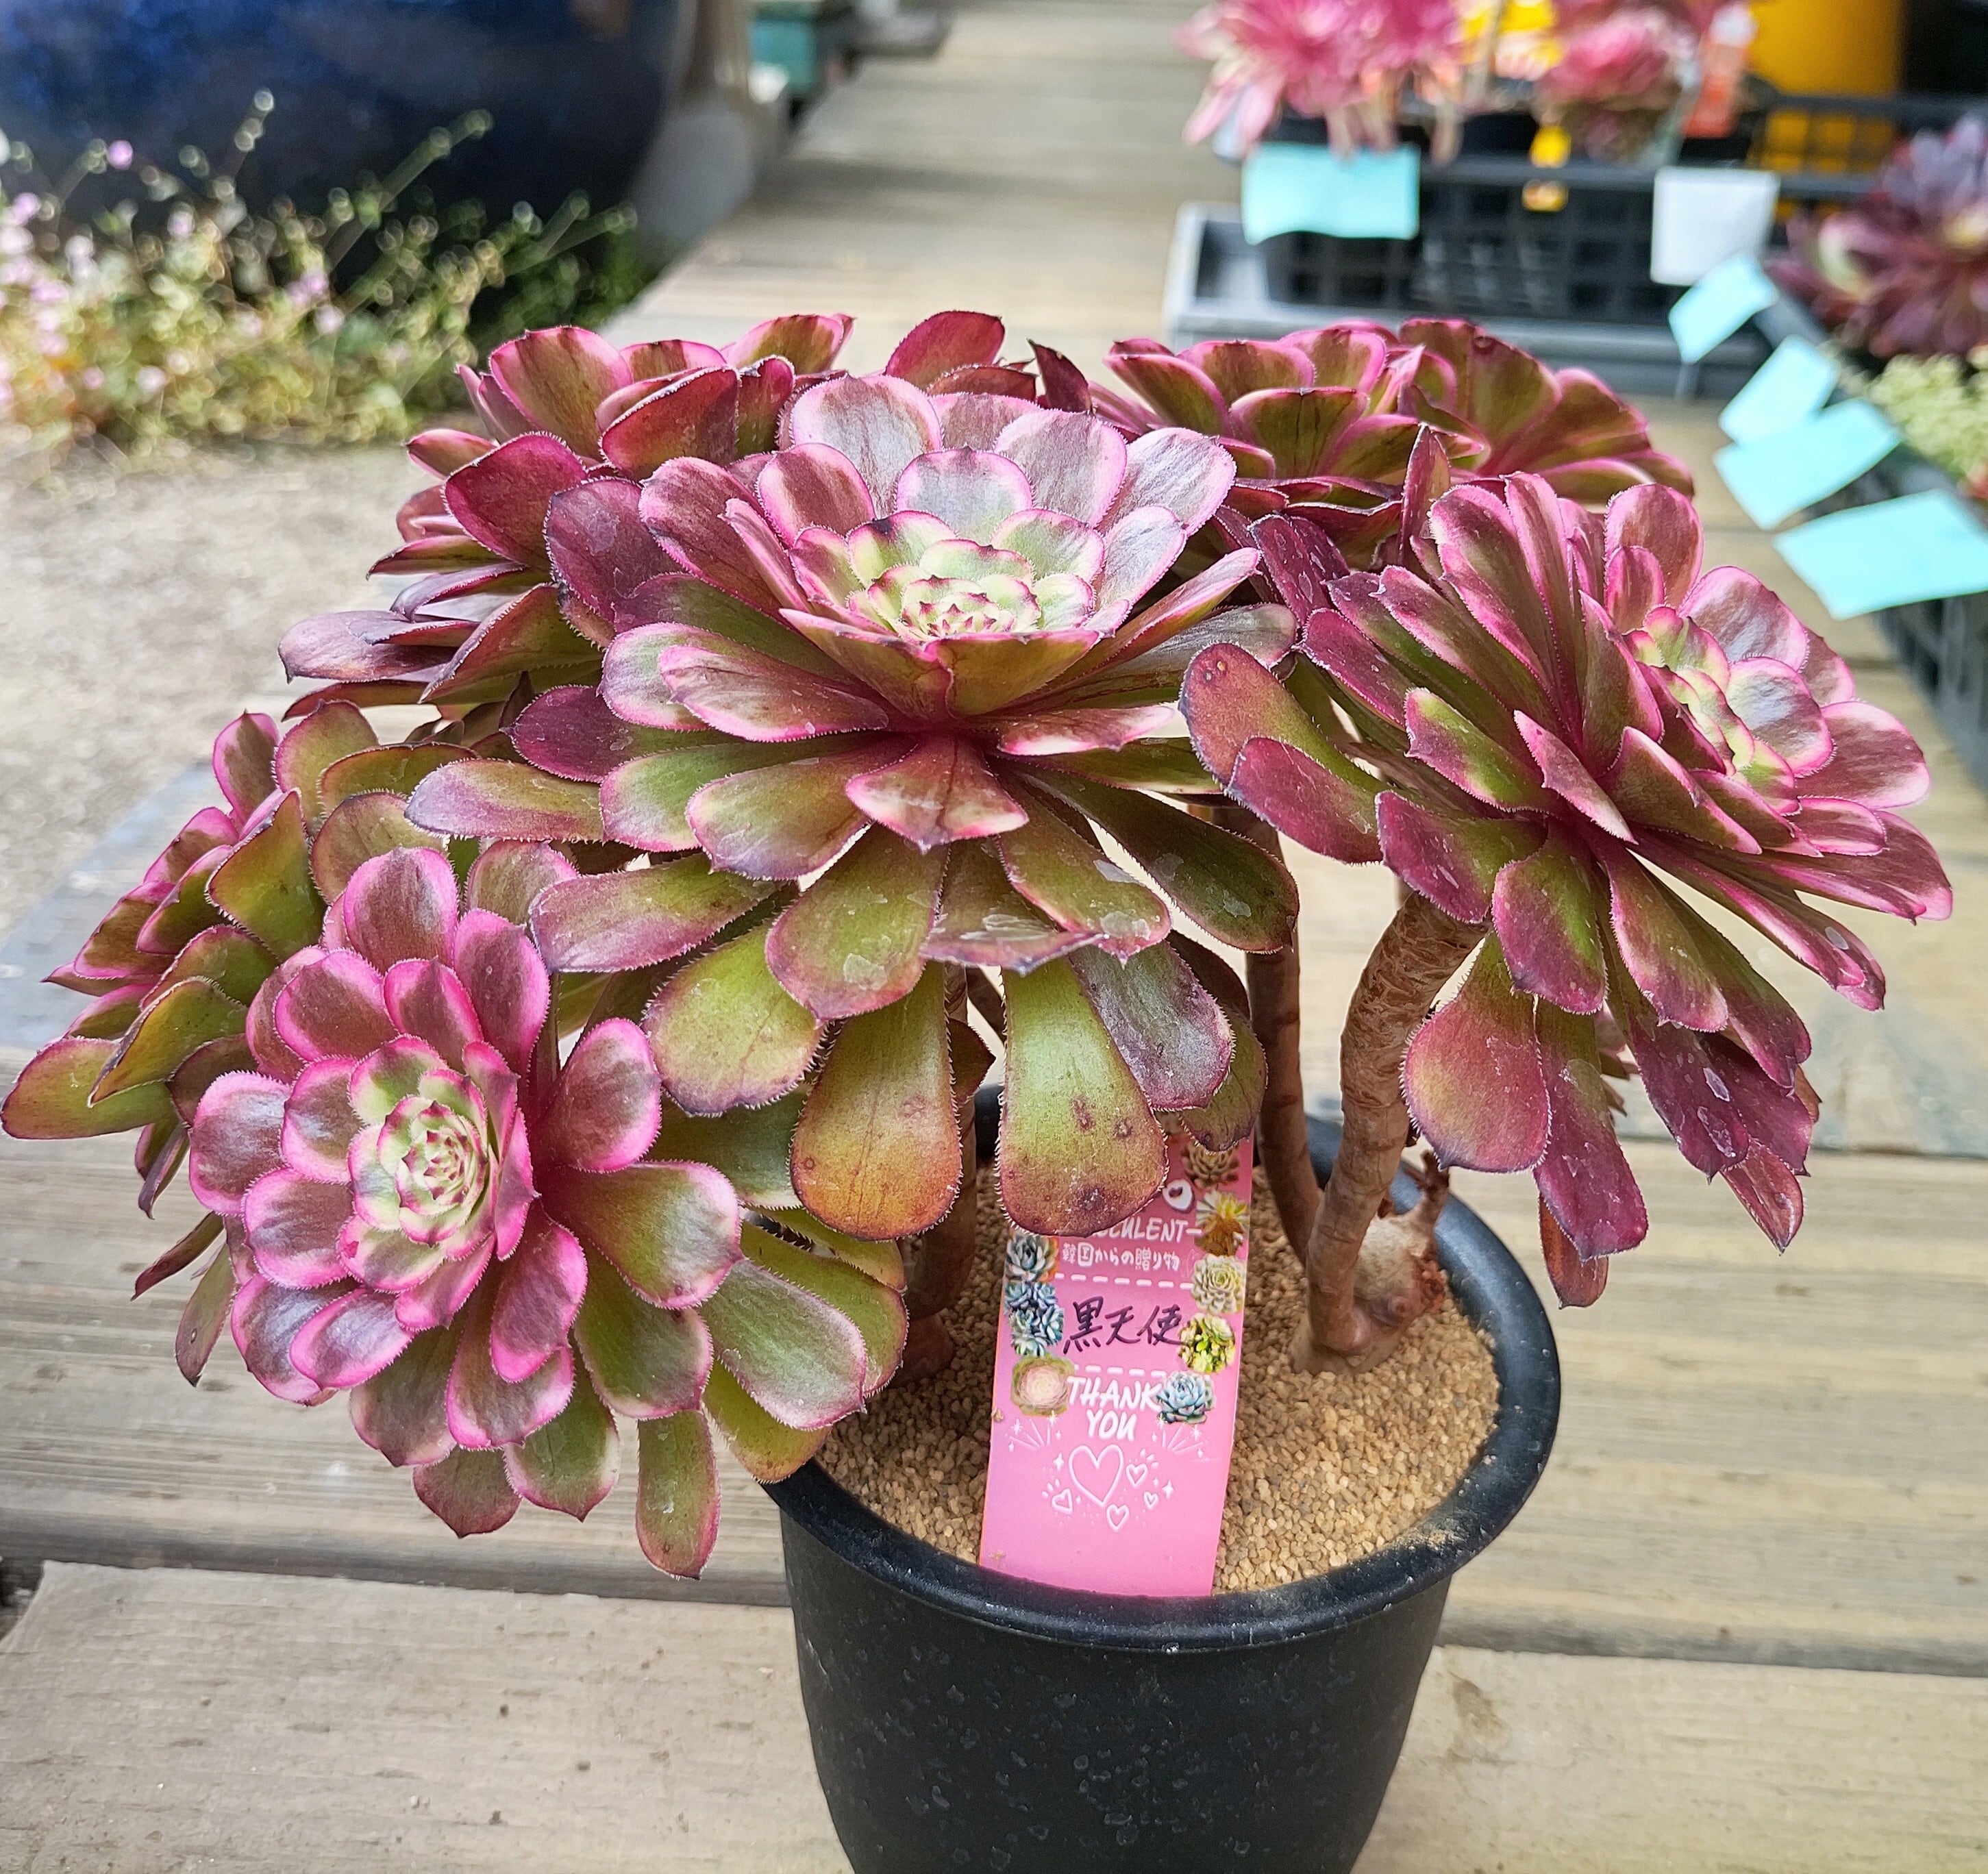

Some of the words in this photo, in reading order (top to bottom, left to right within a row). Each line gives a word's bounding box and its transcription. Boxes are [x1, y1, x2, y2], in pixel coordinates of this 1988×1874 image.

[1063, 1242, 1180, 1271] 韓国からの贈り物
[1067, 1376, 1163, 1412] THANK
[1086, 1409, 1137, 1441] YOU
